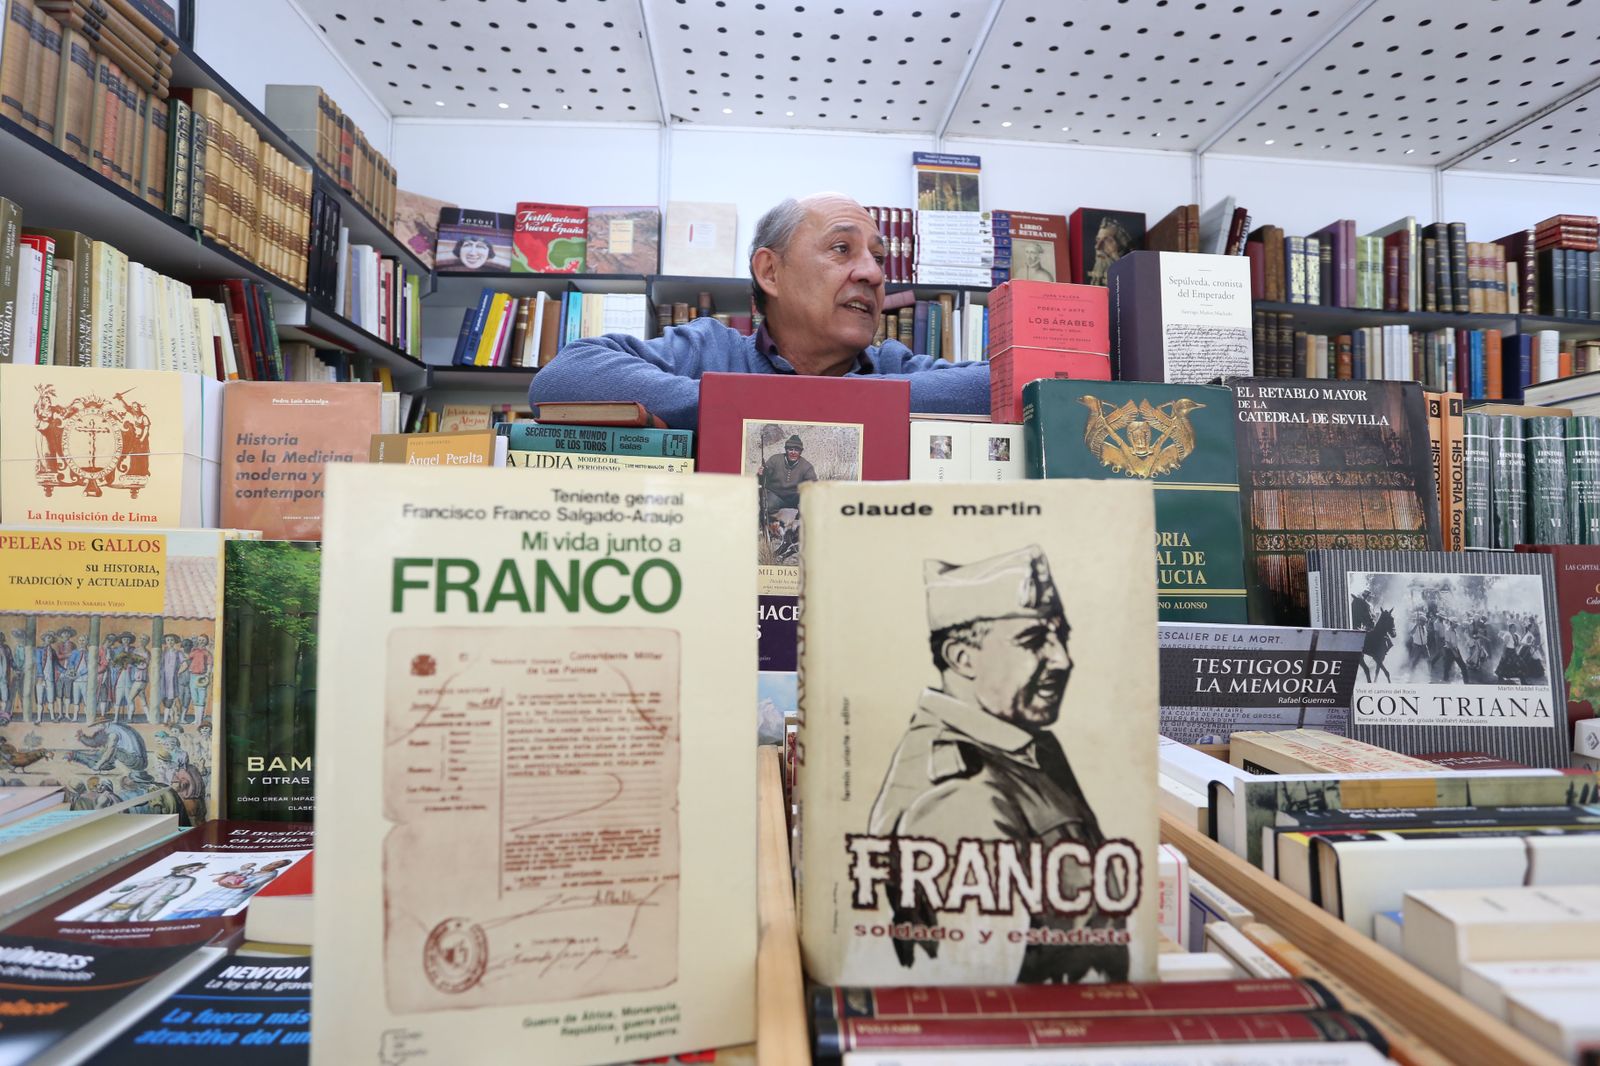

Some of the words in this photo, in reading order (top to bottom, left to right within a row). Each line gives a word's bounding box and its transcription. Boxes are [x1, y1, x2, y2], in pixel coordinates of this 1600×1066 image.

[1169, 276, 1210, 287] Sepúlveda,
[1177, 289, 1189, 297] del
[1192, 289, 1235, 301] Emperador
[1028, 317, 1049, 325] LOS
[1052, 317, 1095, 328] ÁRABES
[1237, 387, 1254, 398] EL
[1258, 387, 1319, 400] RETABLO
[1322, 389, 1368, 401] MAYOR
[1238, 400, 1251, 409] DE
[1252, 400, 1268, 409] LA
[1430, 402, 1439, 416] 3
[1452, 401, 1461, 414] 1
[1238, 410, 1309, 424] CATEDRAL
[1312, 412, 1329, 424] DE
[1331, 413, 1390, 426] SEVILLA
[236, 433, 299, 446] Historia
[525, 427, 561, 438] SECRETOS
[564, 428, 577, 438] DEL
[579, 429, 607, 440] MUNDO
[619, 433, 649, 443] nicolas
[555, 441, 566, 449] DE
[568, 441, 580, 450] LOS
[583, 442, 607, 451] TOROS
[236, 450, 255, 463] de
[261, 450, 276, 463] la
[282, 450, 353, 463] Medicina
[409, 452, 439, 465] Ángel
[446, 452, 483, 464] Peralta
[524, 454, 573, 469] LIDIA
[236, 468, 307, 481] moderna
[311, 472, 322, 484] y
[1452, 440, 1462, 504] HISTORIA
[552, 488, 620, 505] Teniente
[625, 493, 684, 508] general
[402, 503, 486, 520] Francisco
[493, 506, 550, 522] Franco
[557, 507, 684, 525] Salgado-Araujo
[840, 501, 934, 517] claude
[952, 501, 1042, 516] martin
[27, 510, 42, 520] La
[45, 510, 108, 523] Inquisición
[112, 512, 125, 522] de
[128, 512, 158, 523] Lima
[1453, 509, 1462, 551] forges
[0, 536, 62, 551] PELEAS
[68, 541, 85, 550] DE
[91, 538, 160, 553] GALLOS
[522, 531, 548, 551] Mi
[554, 532, 599, 552] vida
[605, 534, 662, 557] junto
[668, 538, 681, 552] a
[1181, 551, 1206, 565] DE
[85, 564, 99, 572] su
[103, 563, 160, 575] HISTORIA,
[758, 568, 774, 576] MIL
[777, 568, 798, 576] DÍAS
[8, 574, 73, 585] TRADICIÓN
[77, 578, 84, 589] y
[87, 577, 160, 588] ACTUALIDAD
[1156, 569, 1207, 584] UCIA
[390, 557, 682, 614] FRANCO
[1173, 601, 1208, 609] ALONSO
[1214, 634, 1228, 642] DE
[1233, 634, 1244, 642] LA
[1192, 658, 1304, 675] TESTIGOS
[1311, 659, 1342, 676] DE
[1195, 677, 1222, 693] LA
[1227, 677, 1338, 694] MEMORIA
[1278, 696, 1300, 704] Rafael
[1302, 696, 1335, 704] Guerrero
[1356, 695, 1420, 716] CON
[1433, 697, 1550, 718] TRIANA
[247, 757, 311, 771] BAM
[262, 777, 310, 785] OTRAS
[844, 832, 1144, 918] FRANCO
[853, 921, 965, 943] soldado
[979, 927, 993, 945] y
[1006, 924, 1132, 946] estadista
[218, 965, 310, 980] NEWTON
[205, 979, 221, 989] La
[222, 980, 244, 991] ley
[243, 980, 262, 990] de
[262, 980, 275, 990] la
[161, 1007, 192, 1024] La
[192, 1007, 264, 1025] fuerza
[264, 1008, 312, 1025] más
[522, 1017, 559, 1029] Guerra
[563, 1014, 577, 1023] de
[623, 1019, 655, 1030] guerra
[659, 1014, 680, 1024] civil
[134, 1028, 240, 1045] atractiva
[240, 1029, 283, 1046] del
